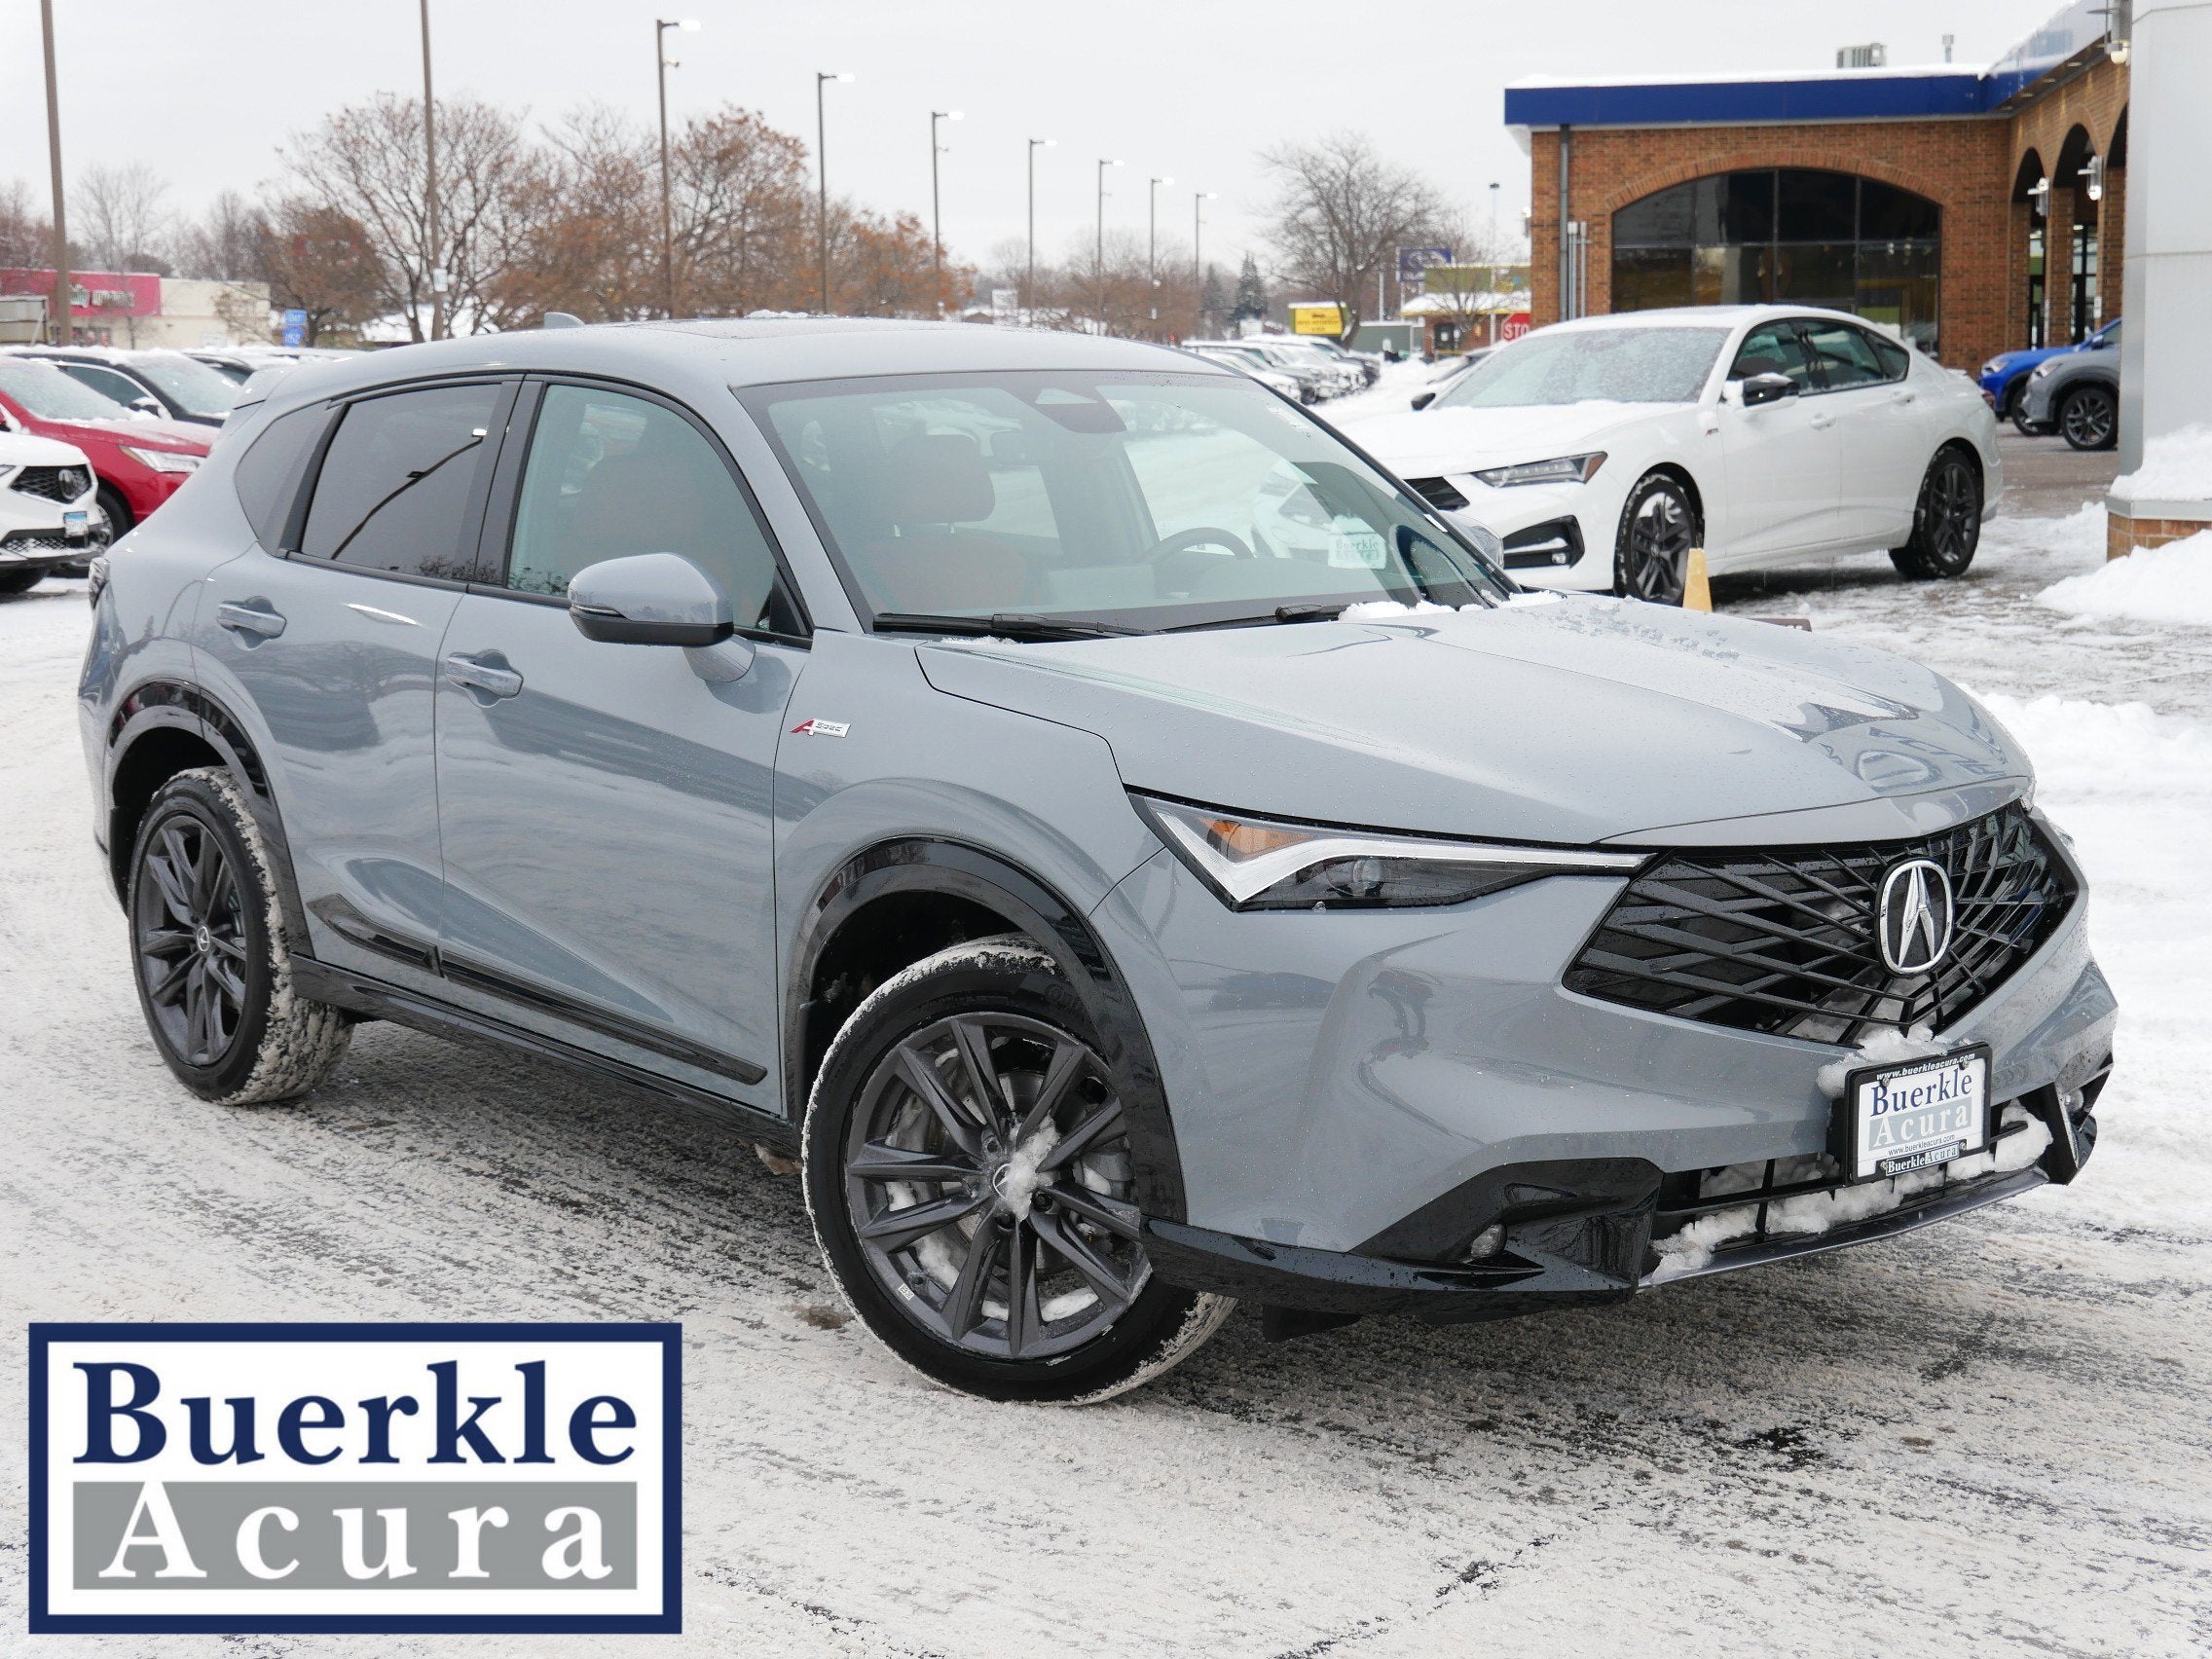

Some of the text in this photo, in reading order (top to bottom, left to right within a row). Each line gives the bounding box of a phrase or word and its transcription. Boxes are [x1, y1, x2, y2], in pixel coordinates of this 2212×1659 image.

[1503, 322, 1530, 340] STO
[1876, 1052, 1975, 1081] www.buerkleacura.com
[1870, 1068, 1972, 1117] Buerkle
[1872, 1105, 1969, 1147] Acura
[1889, 1134, 1955, 1156] www.buerkleacura.com
